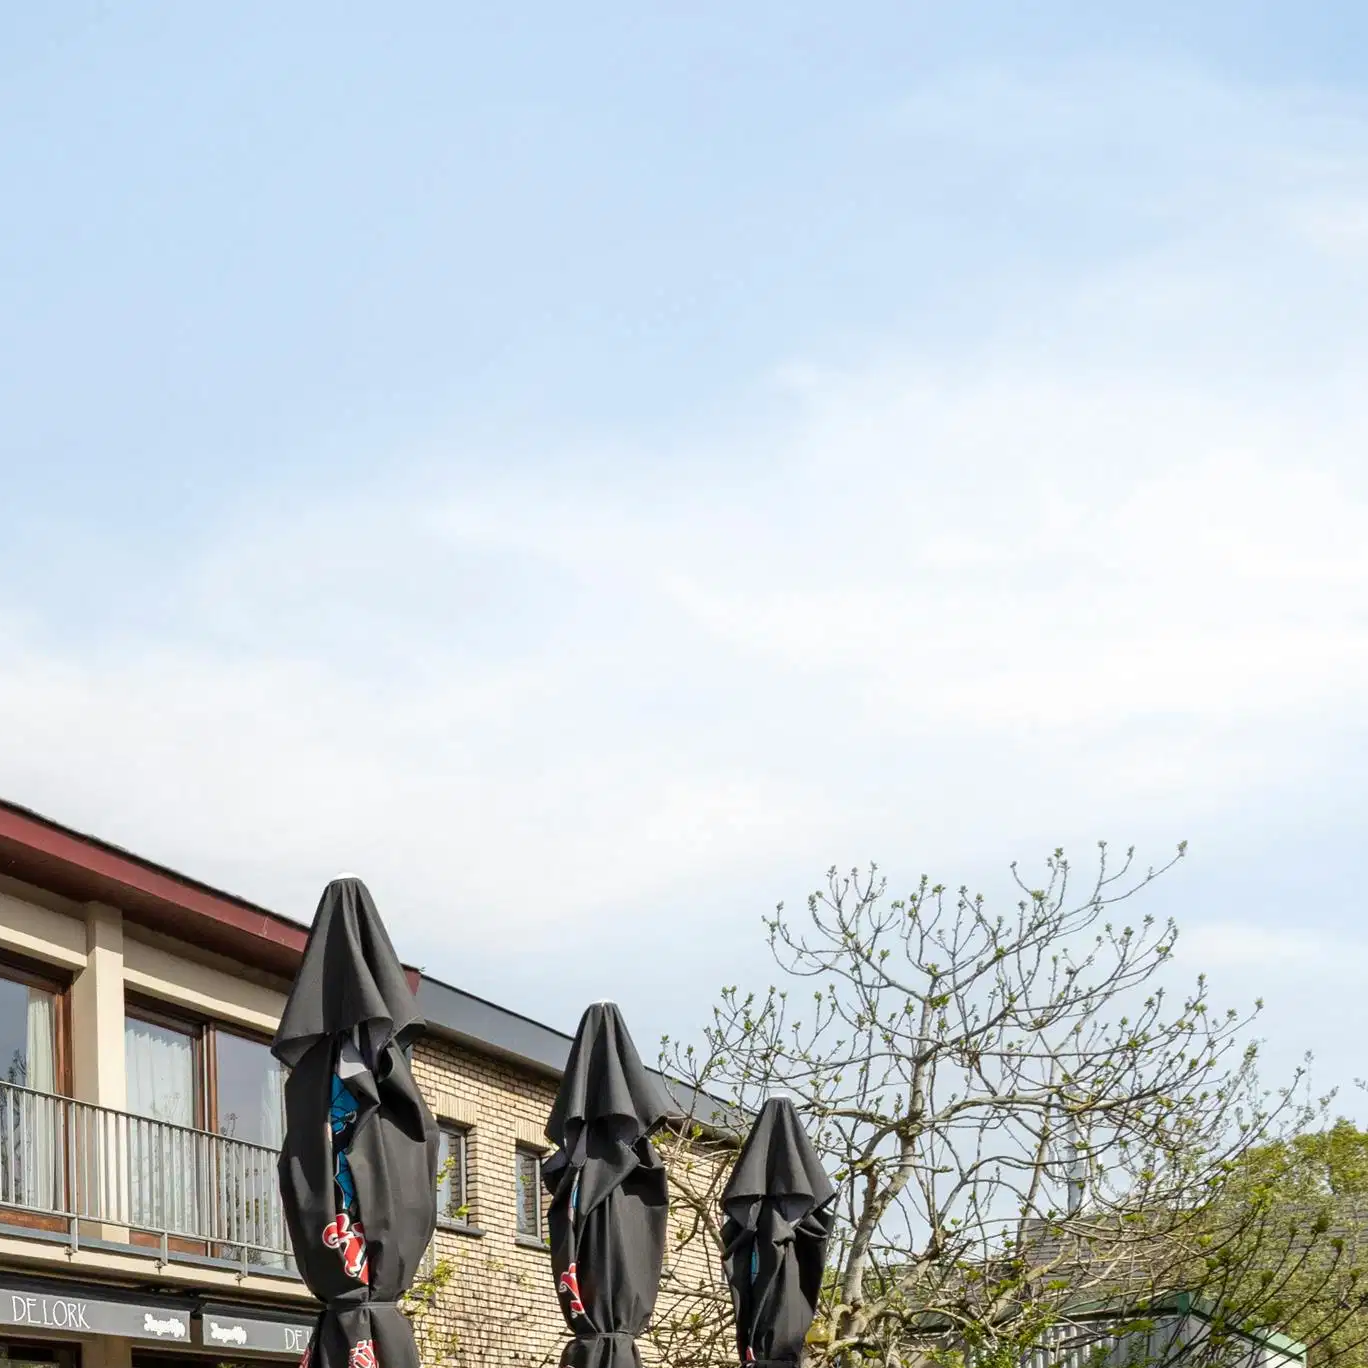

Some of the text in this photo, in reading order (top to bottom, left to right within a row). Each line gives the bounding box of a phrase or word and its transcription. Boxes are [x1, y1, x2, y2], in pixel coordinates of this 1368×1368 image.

[11, 1295, 92, 1330] DE LORK
[284, 1327, 306, 1352] DE
